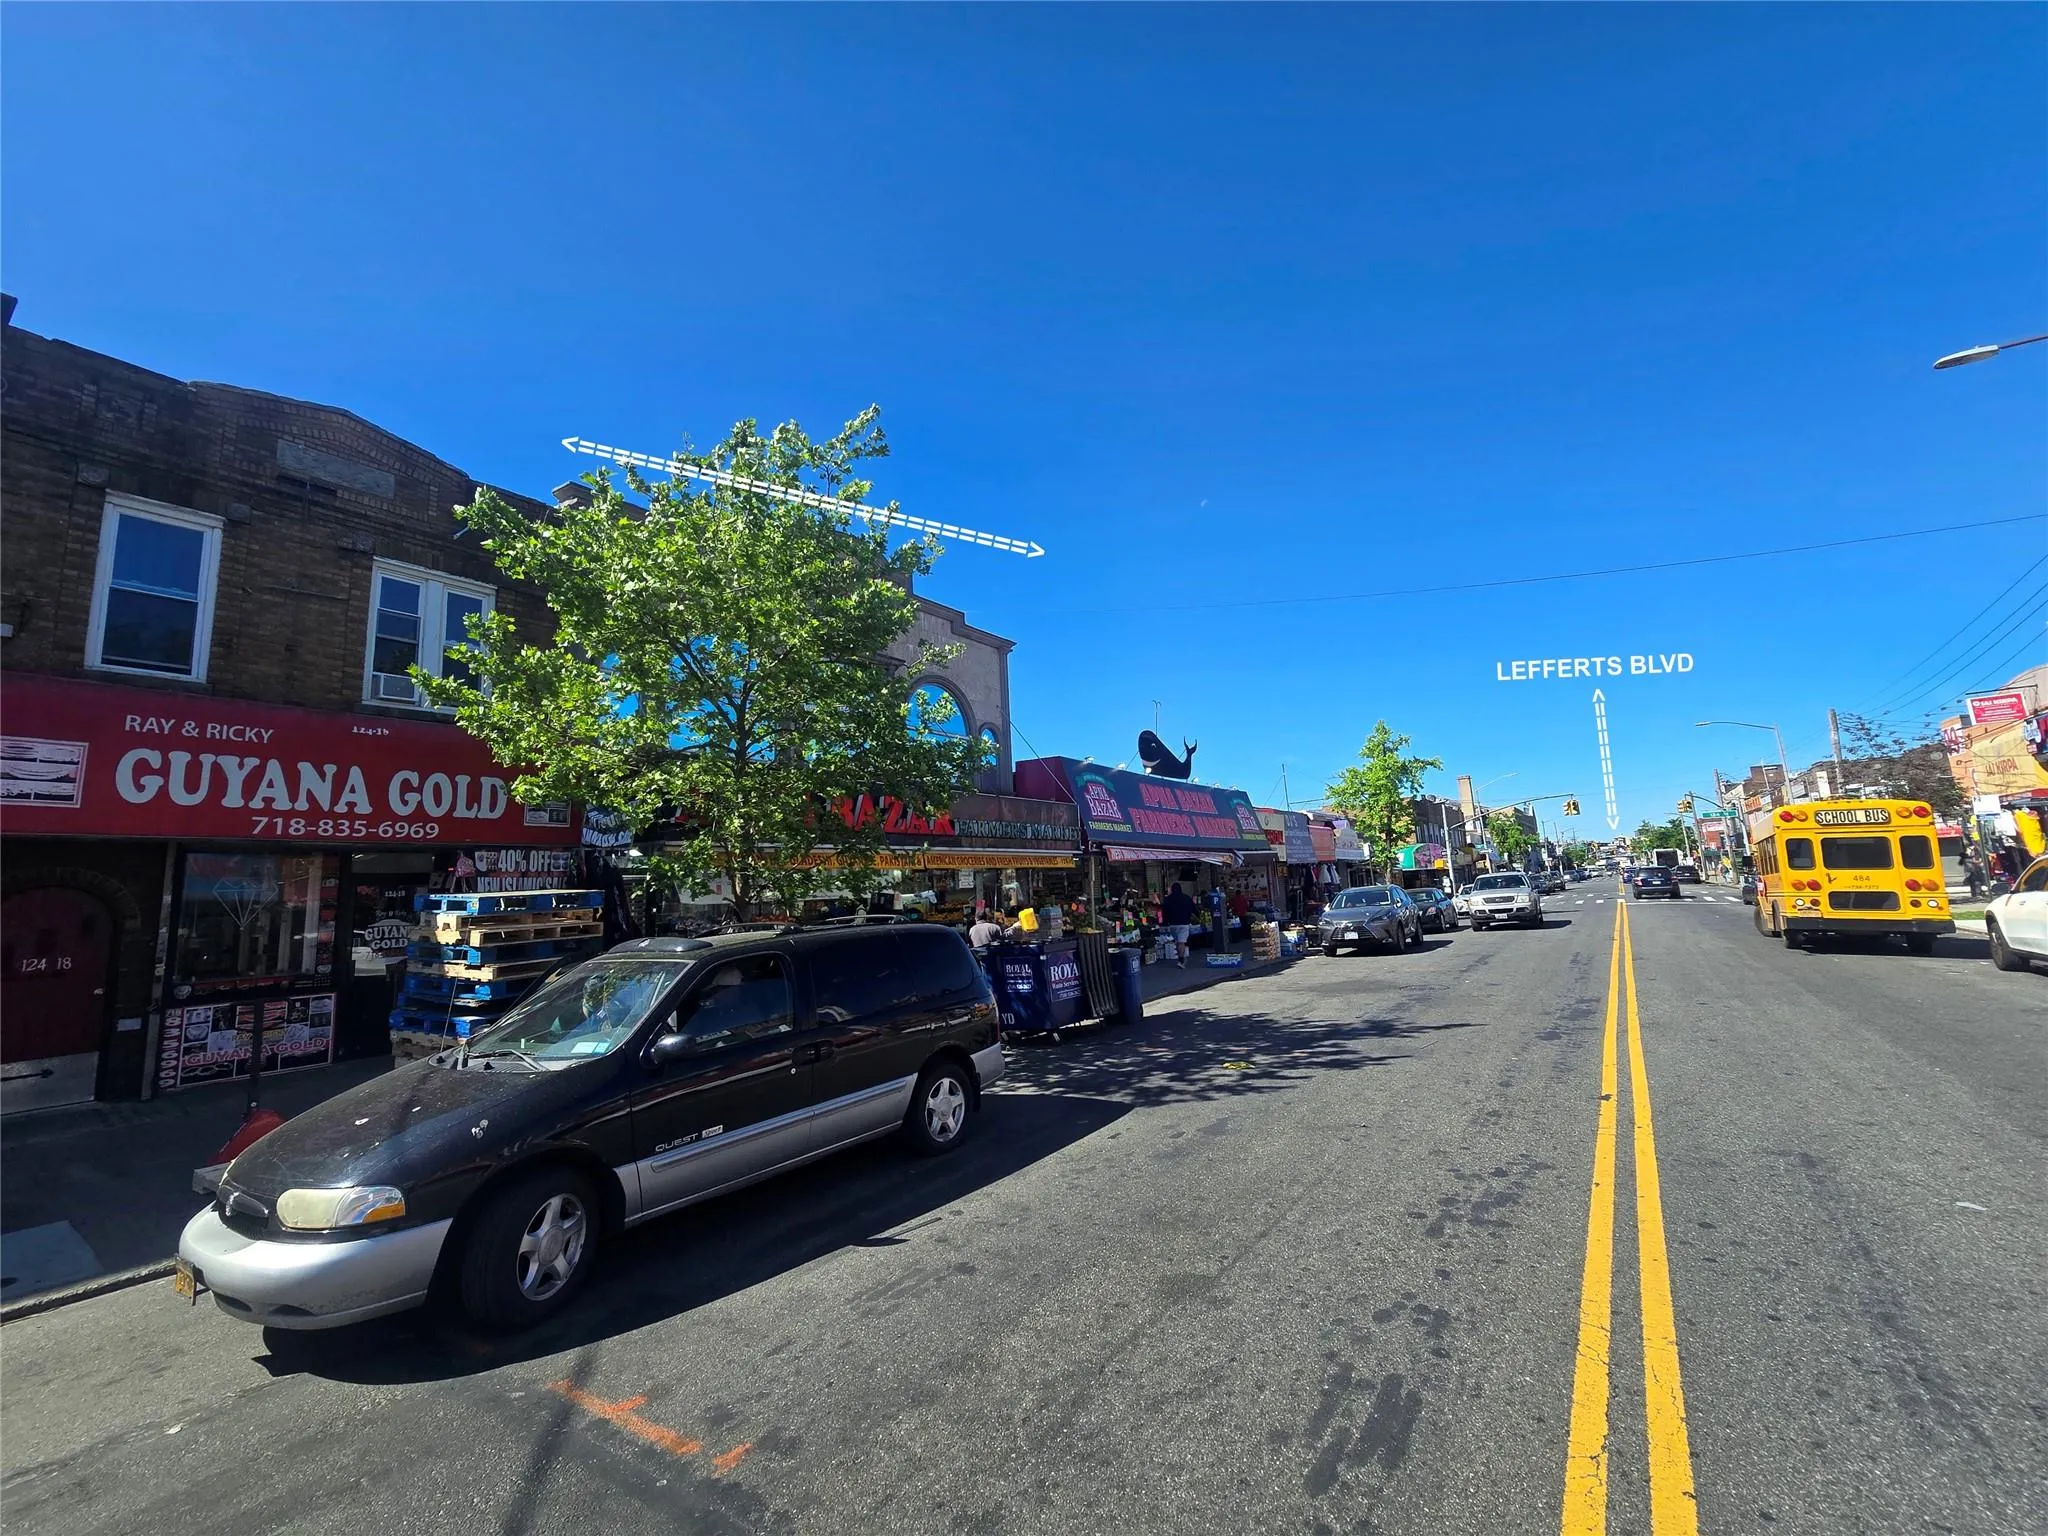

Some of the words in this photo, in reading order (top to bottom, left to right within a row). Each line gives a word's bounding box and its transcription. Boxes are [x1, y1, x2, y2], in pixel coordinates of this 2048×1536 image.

[125, 715, 176, 734] RAY
[182, 720, 200, 737] &
[206, 723, 274, 744] RICKY
[115, 748, 373, 814] GUYANA
[388, 769, 508, 820] GOLD
[1084, 792, 1122, 819] BAZAR
[1128, 807, 1196, 837] FARMERS
[1817, 811, 1861, 824] SCHOOL
[1864, 809, 1889, 821] BUS
[251, 816, 439, 839] 718-835-6969
[498, 849, 527, 873] 40%
[529, 850, 551, 873] OFF
[364, 926, 409, 941] GUYAN
[371, 938, 408, 950] GOLD
[21, 958, 47, 972] 124
[57, 957, 72, 970] 18
[1006, 963, 1032, 973] ROYAL
[1050, 962, 1079, 982] ROYA
[1001, 1013, 1015, 1025] YD
[275, 1038, 328, 1054] GOLD
[655, 1132, 699, 1152] QUEST
